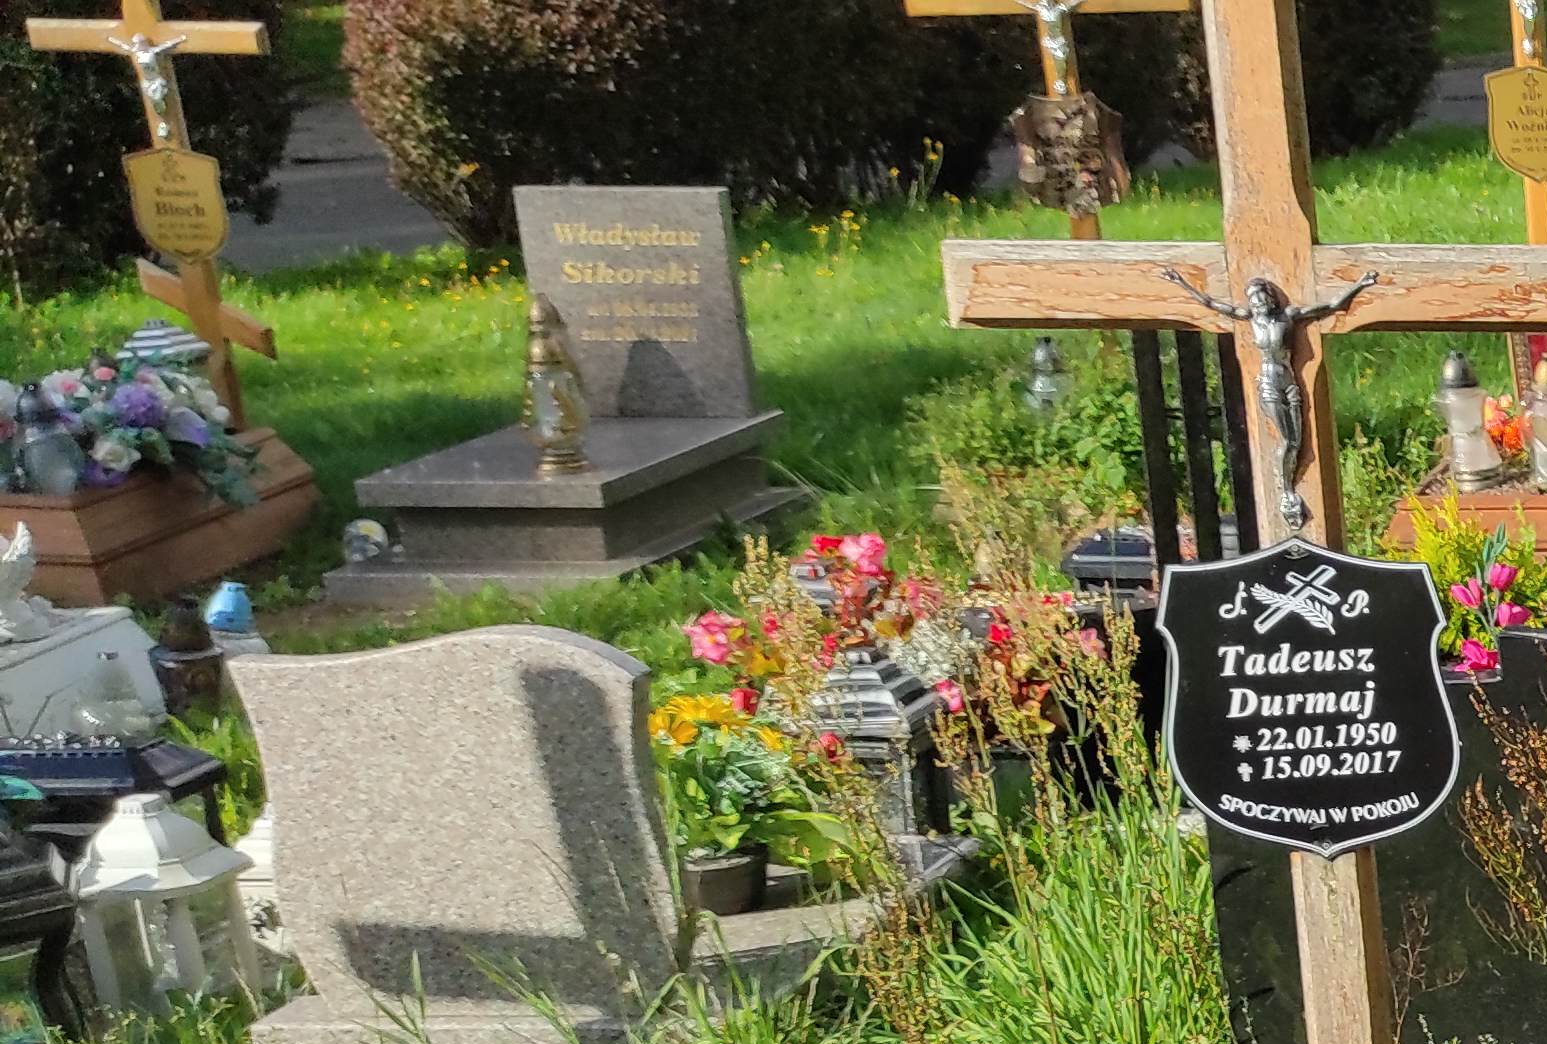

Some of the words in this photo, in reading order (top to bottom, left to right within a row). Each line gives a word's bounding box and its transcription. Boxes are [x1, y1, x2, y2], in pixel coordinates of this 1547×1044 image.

[553, 222, 701, 251] Władysław
[561, 260, 701, 285] Sikorski
[1217, 643, 1376, 677] Tadeusz
[1225, 681, 1376, 719] Durmaj
[1256, 721, 1397, 751] 22.01.1950
[1261, 750, 1402, 780] 15.09.2017
[1217, 793, 1327, 824] SPOCZYWAJ
[1328, 807, 1349, 824] W
[1351, 791, 1420, 822] POKOJU
